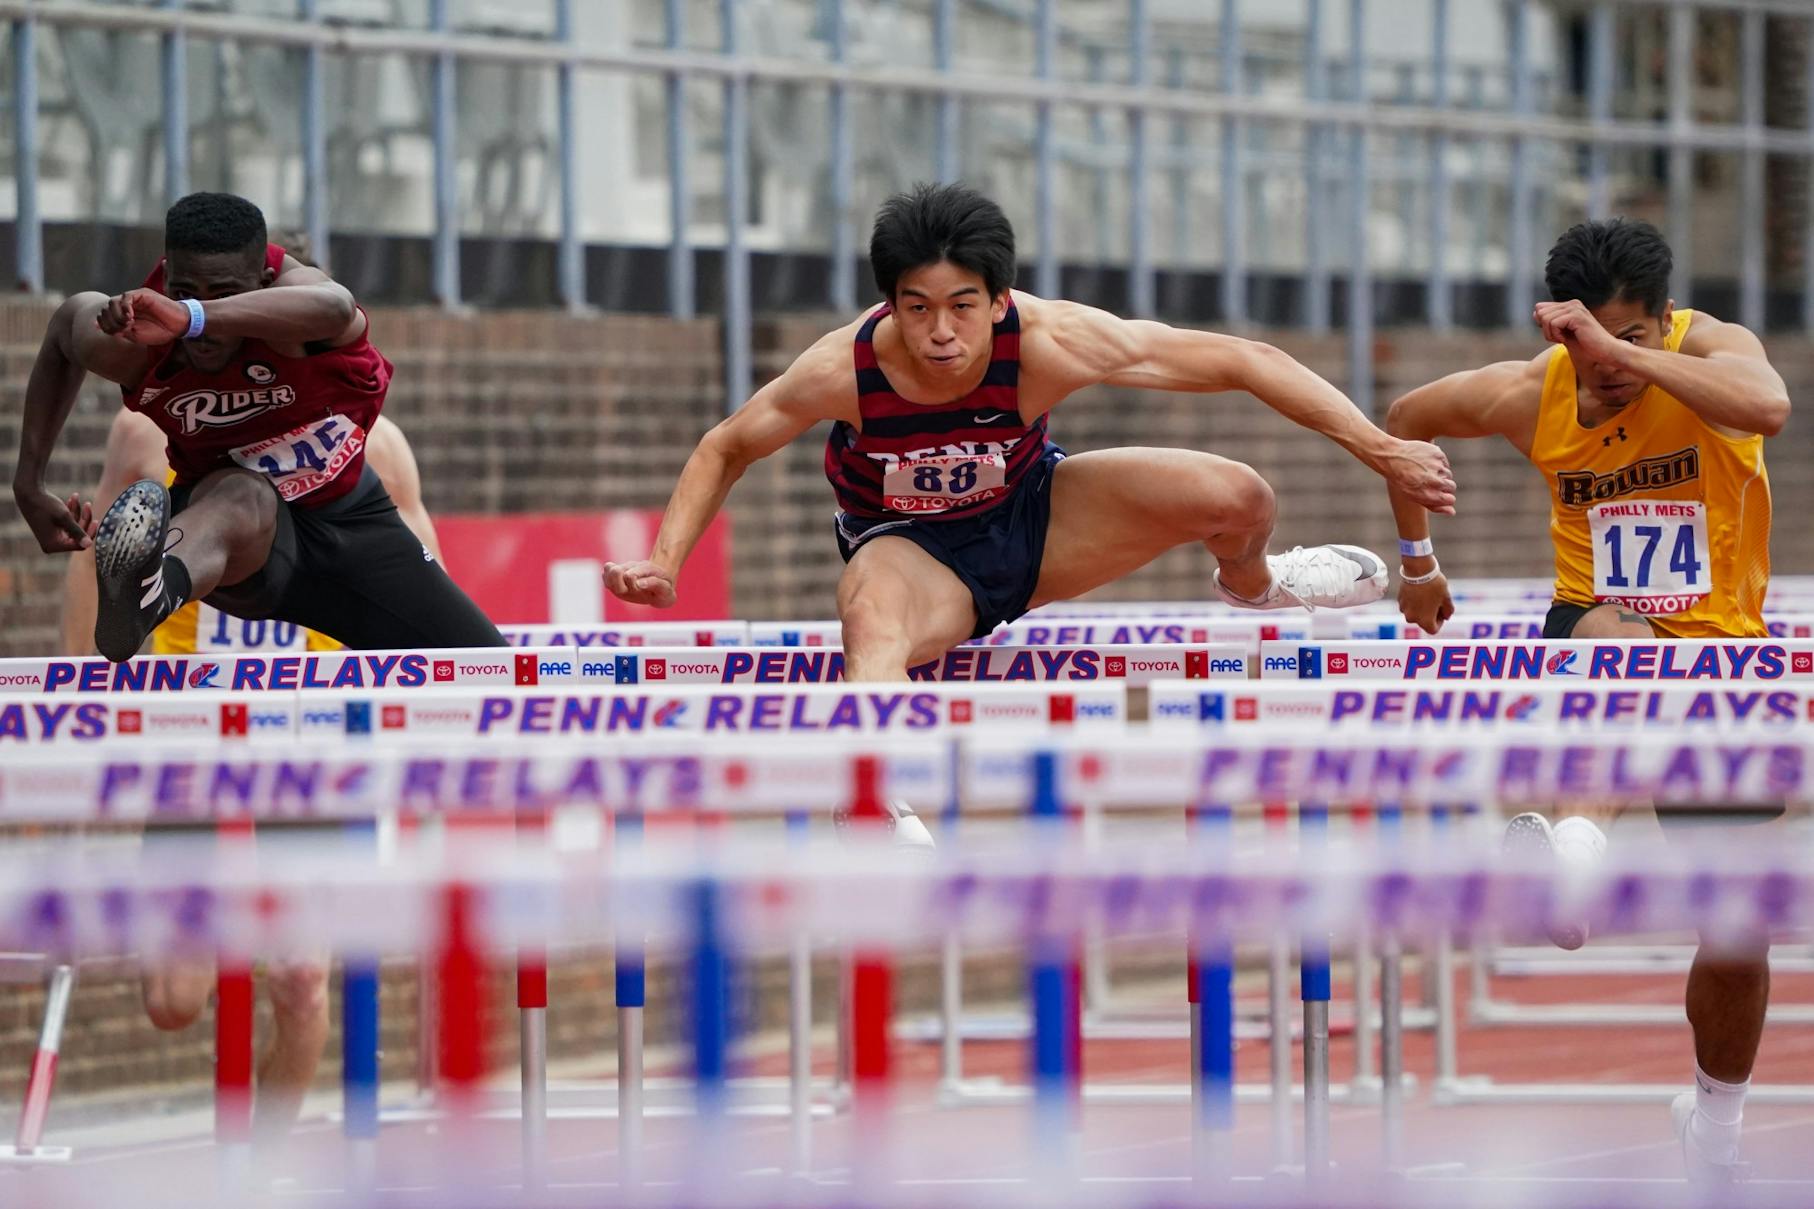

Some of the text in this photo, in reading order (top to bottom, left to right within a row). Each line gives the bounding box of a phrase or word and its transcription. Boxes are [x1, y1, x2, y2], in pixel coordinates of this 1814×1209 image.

[165, 385, 295, 435] RIDER
[300, 435, 361, 489] TOYOTA
[913, 462, 977, 494] 88
[1556, 447, 1700, 508] Rowan
[919, 490, 996, 508] TOYOTA
[1600, 504, 1695, 517] PHILLY METS
[1604, 524, 1701, 588] 174
[1627, 596, 1699, 613] TOYOTA
[1027, 625, 1184, 644] RELAYS
[0, 676, 41, 685] OYOTA
[43, 661, 189, 693] PENN
[232, 655, 428, 691] RELAYS
[459, 665, 508, 675] TOYOTA
[671, 664, 719, 674] TOYOTA
[1131, 661, 1179, 671] TOYOTA
[1353, 658, 1401, 669] TOYOTA
[1403, 646, 1547, 679] PENN
[1589, 645, 1787, 680] RELAYS
[0, 703, 109, 740] AYS
[477, 696, 650, 733] PENN
[705, 693, 942, 731] RELAYS
[1330, 690, 1502, 722] PENN
[1559, 690, 1800, 722] RELAYS
[98, 760, 324, 812] PENN
[400, 756, 703, 810] RELAYS
